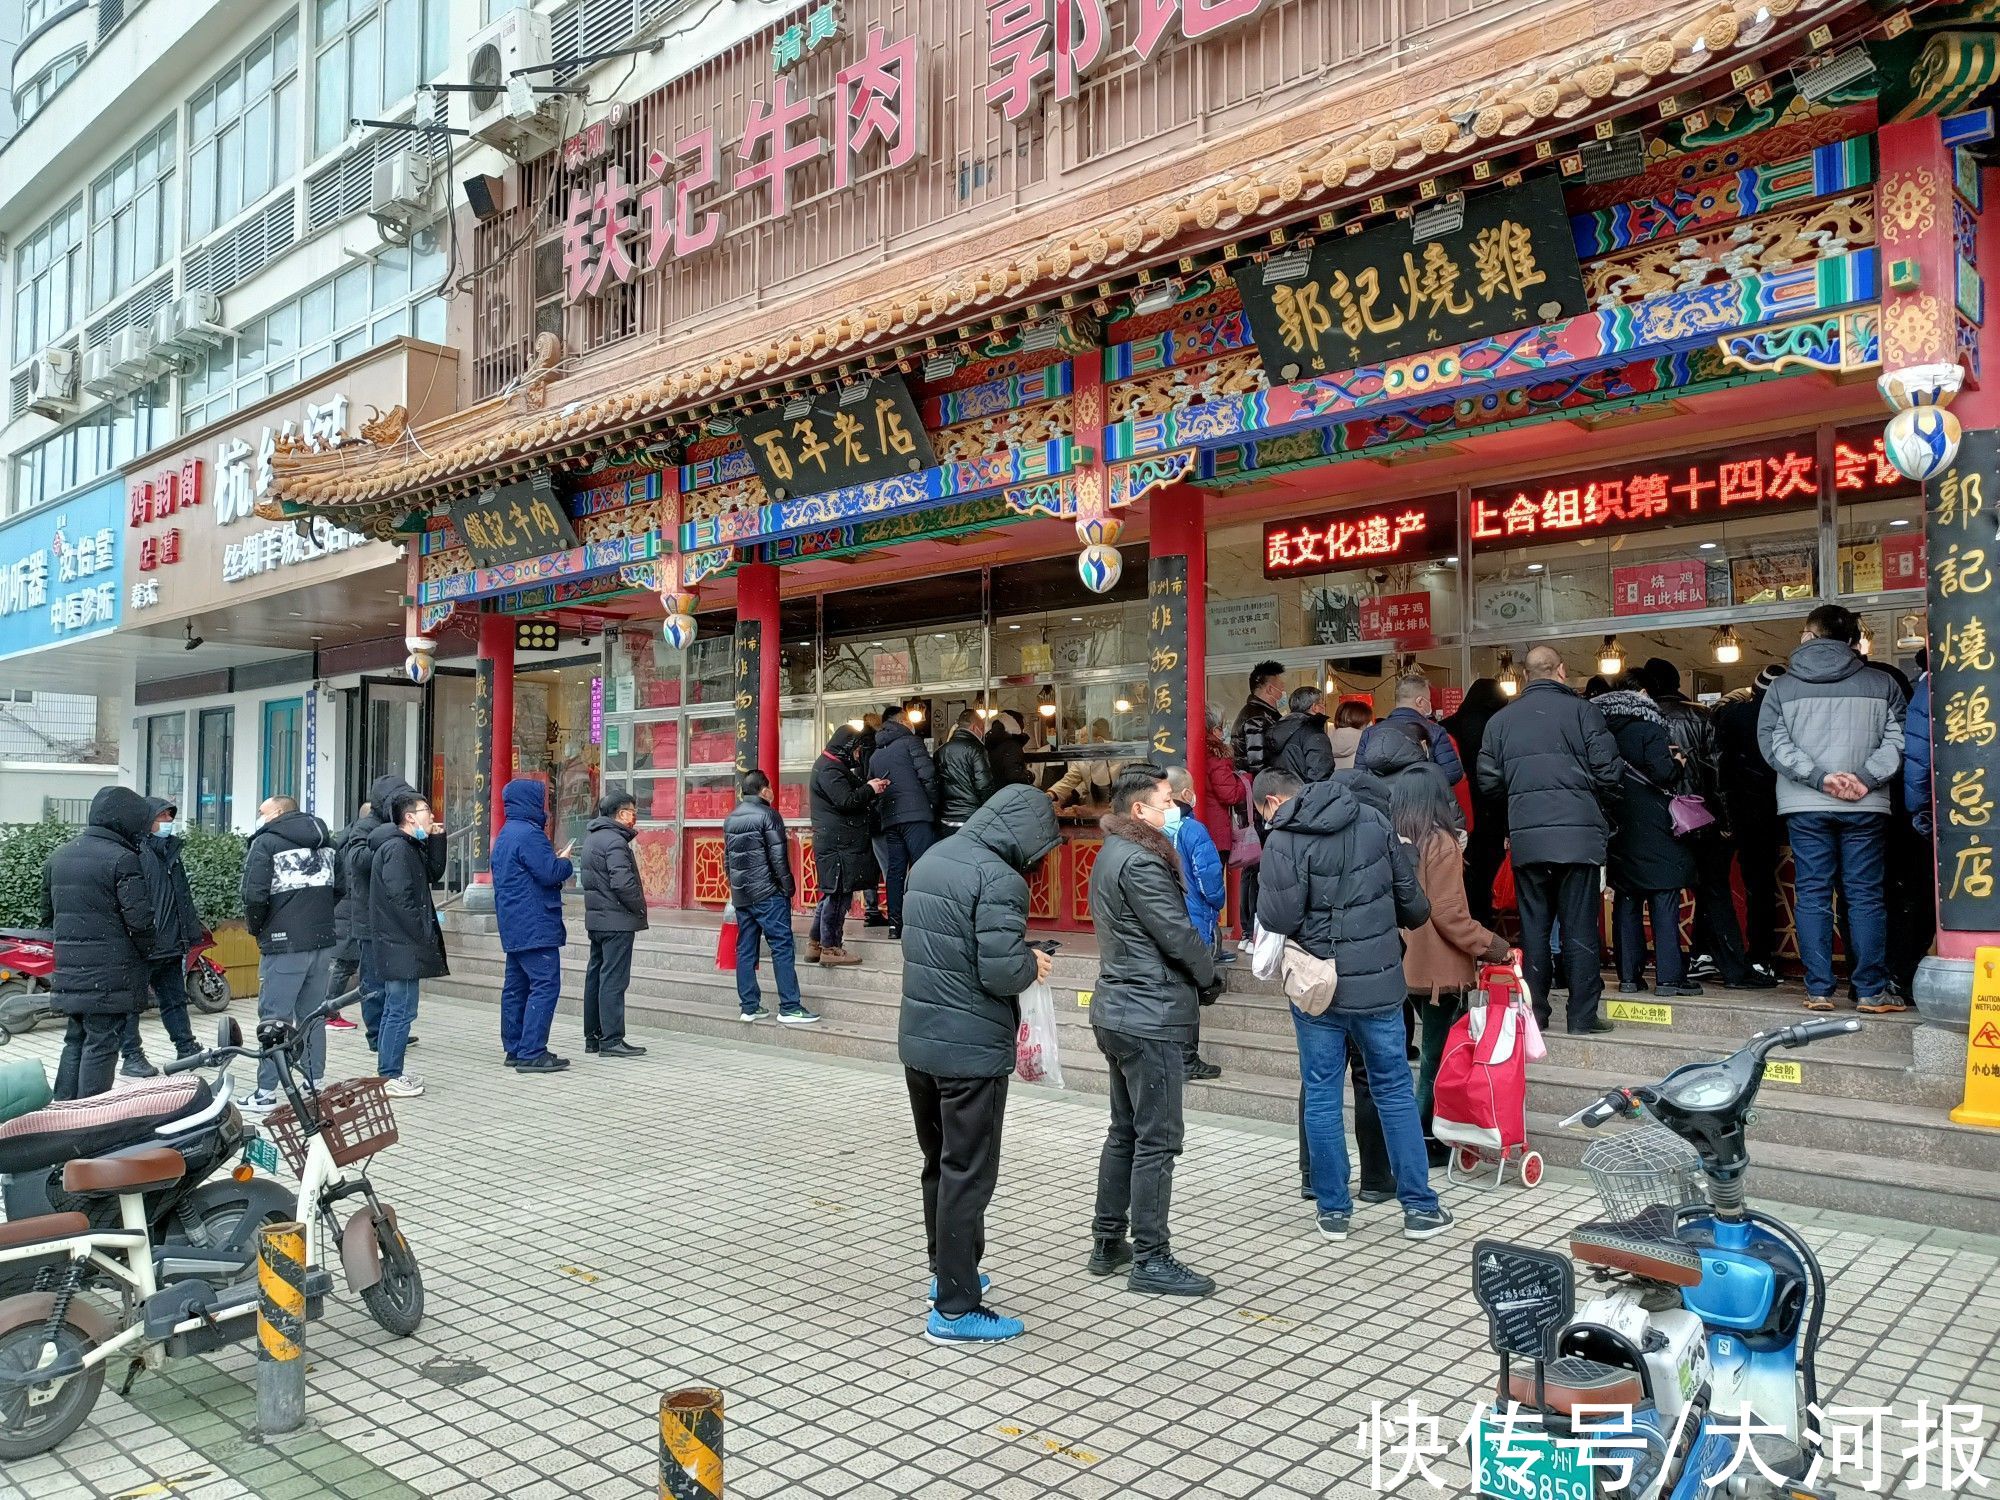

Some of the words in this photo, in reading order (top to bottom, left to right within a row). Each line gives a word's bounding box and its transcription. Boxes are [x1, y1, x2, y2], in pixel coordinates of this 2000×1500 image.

[771, 1, 838, 72] 清真
[563, 27, 917, 302] 铁记牛肉
[753, 398, 917, 481] 百年老店
[51, 581, 116, 634] 中医诊所
[1387, 602, 1425, 618] 桶子鸡
[1643, 588, 1704, 607] 由此排队
[1382, 618, 1430, 633] 由此排队
[1630, 1005, 1667, 1018] 小心台阶
